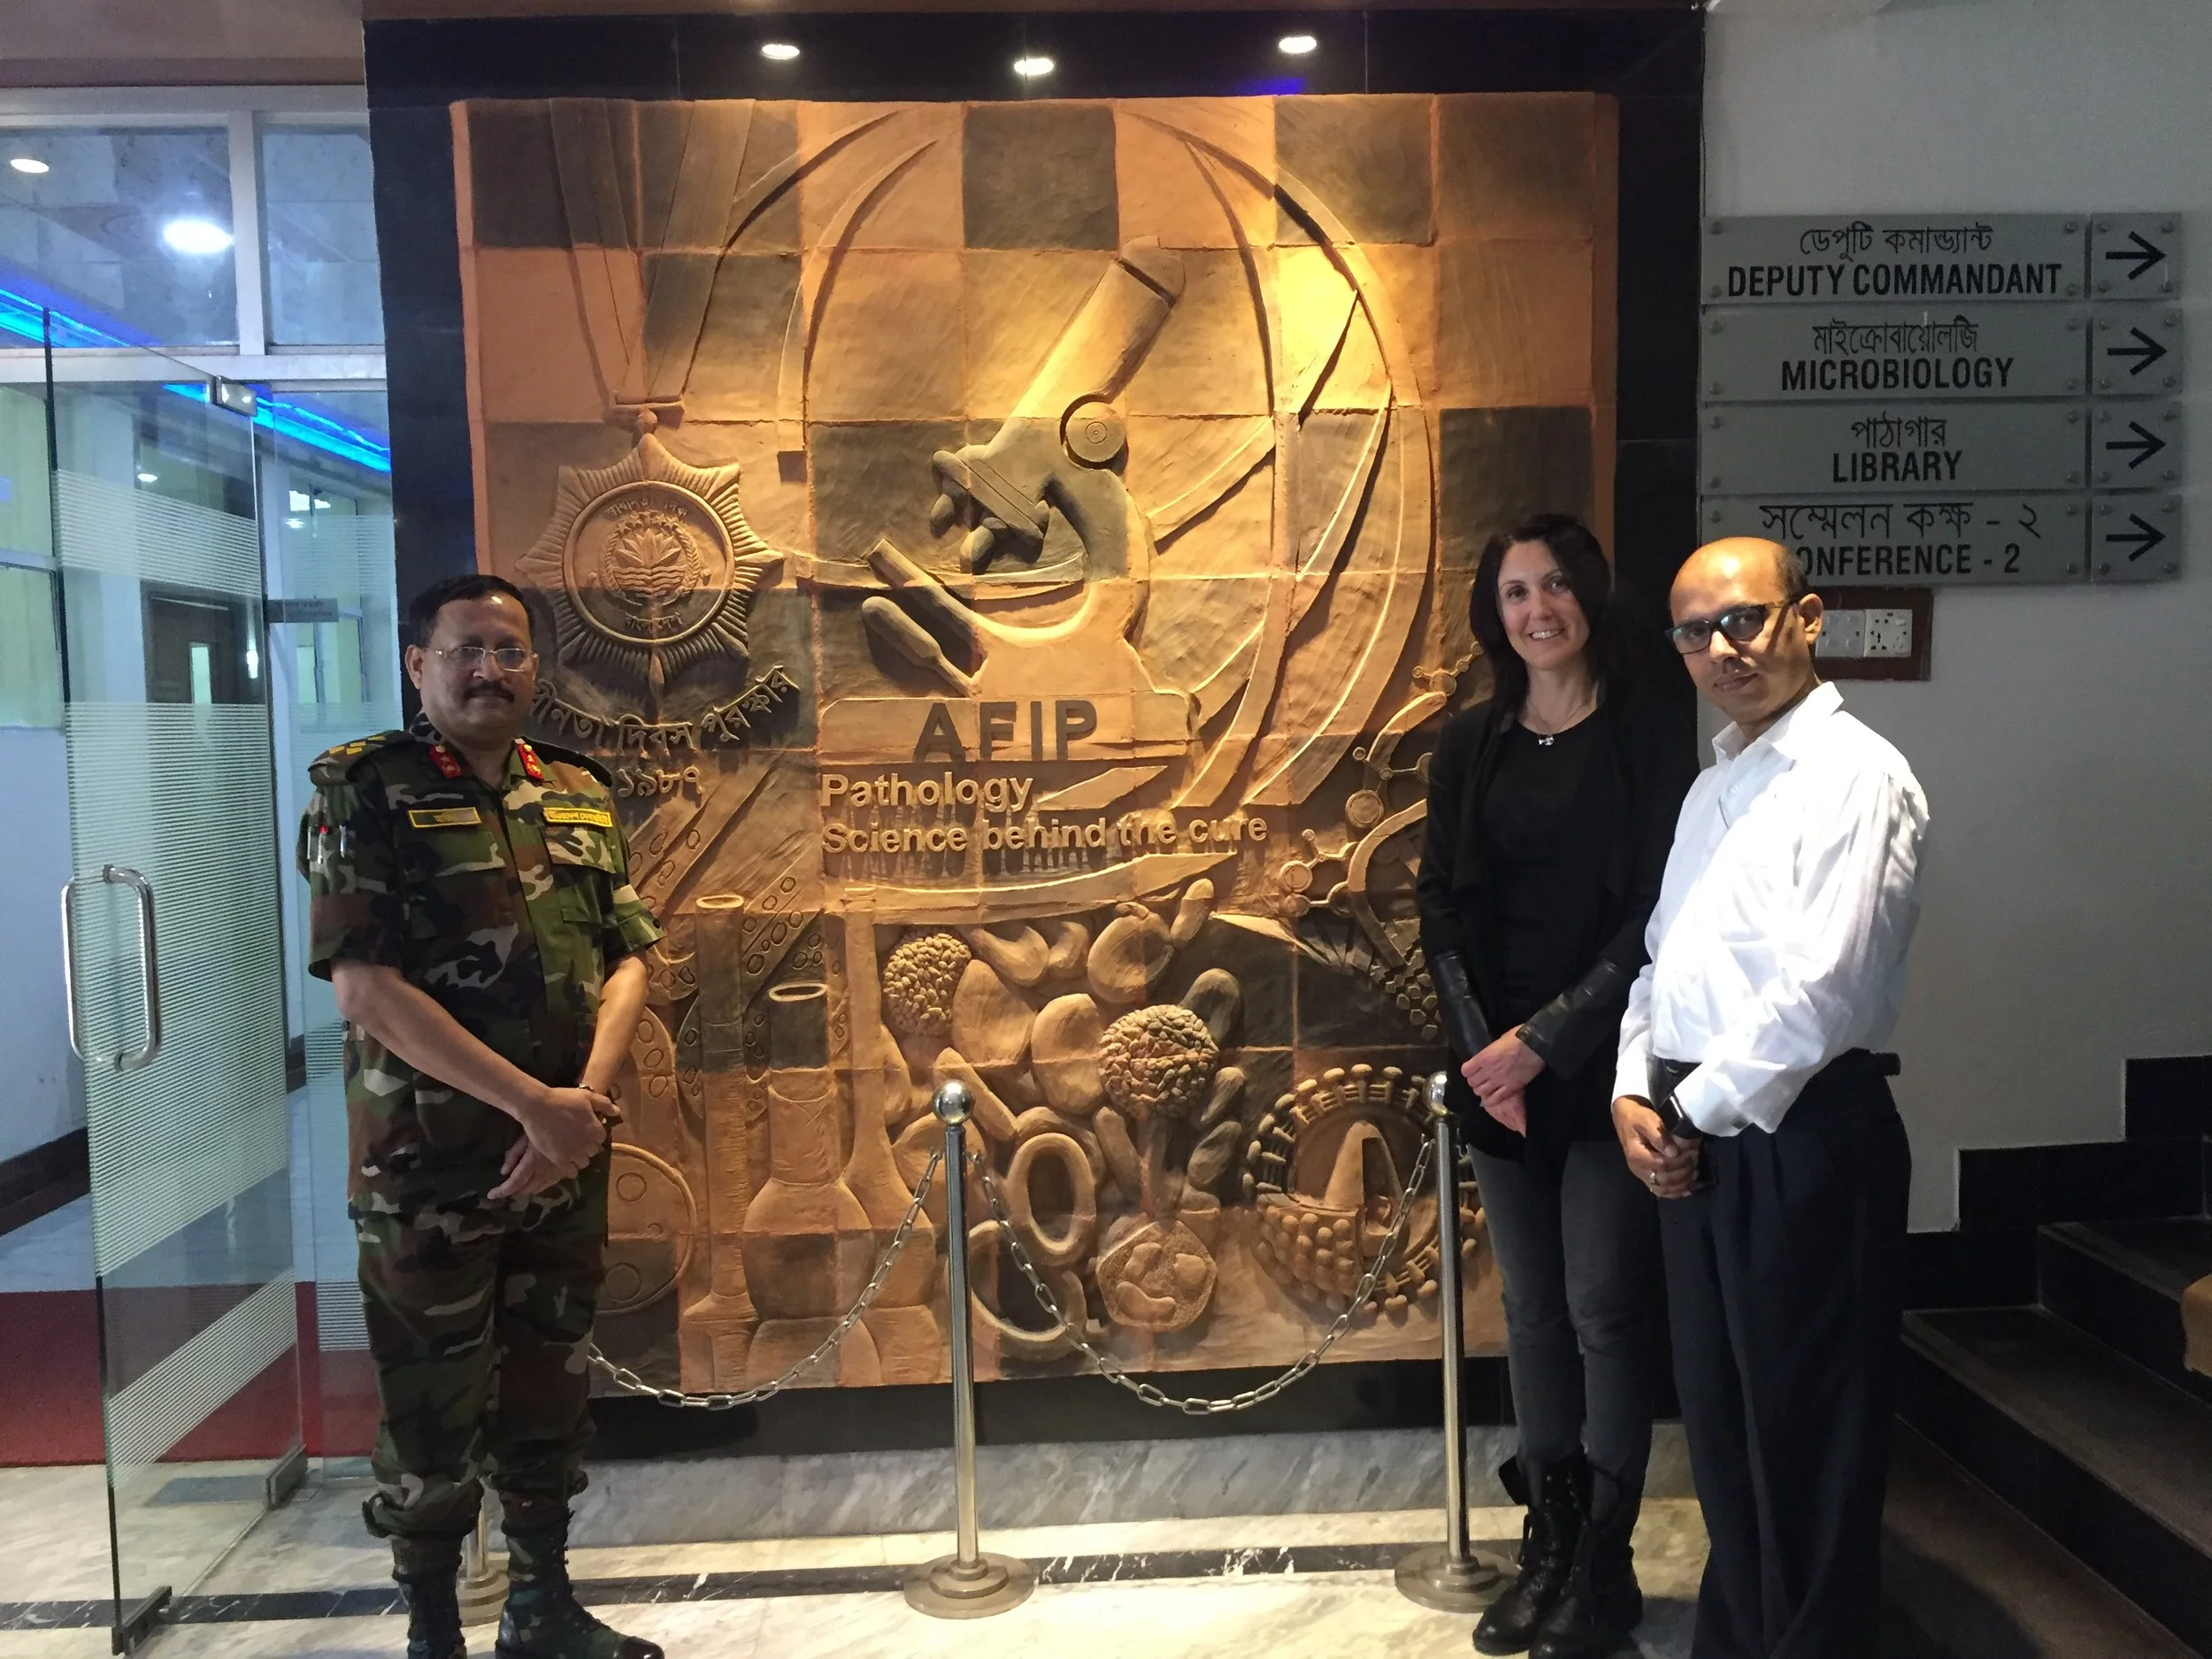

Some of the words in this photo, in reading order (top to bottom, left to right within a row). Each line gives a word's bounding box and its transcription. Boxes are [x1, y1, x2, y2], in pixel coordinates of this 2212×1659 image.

[1800, 220, 1874, 263] ডেপুটি
[1728, 264, 1846, 297] DEPUTY
[1853, 263, 2062, 296] COMMANDANT
[1781, 357, 2015, 391] MICROBIOLOGY
[1850, 410, 1947, 449] পাঠাগার
[1832, 449, 1962, 483] LIBRARY
[1759, 503, 1894, 541] সম্মেলন
[1902, 502, 1974, 538] কক্ষ
[2018, 503, 2041, 539] ২
[1797, 543, 1971, 576] ONFERENCE
[2003, 542, 2021, 573] 2
[617, 713, 694, 757] দিবস
[913, 699, 1097, 763] AFIP
[618, 765, 704, 797] ১৯৮৭
[820, 772, 1033, 812] Pathology
[821, 824, 968, 853] Science
[982, 817, 1107, 850] behind
[1117, 811, 1177, 846] the
[1188, 814, 1268, 844] cure
